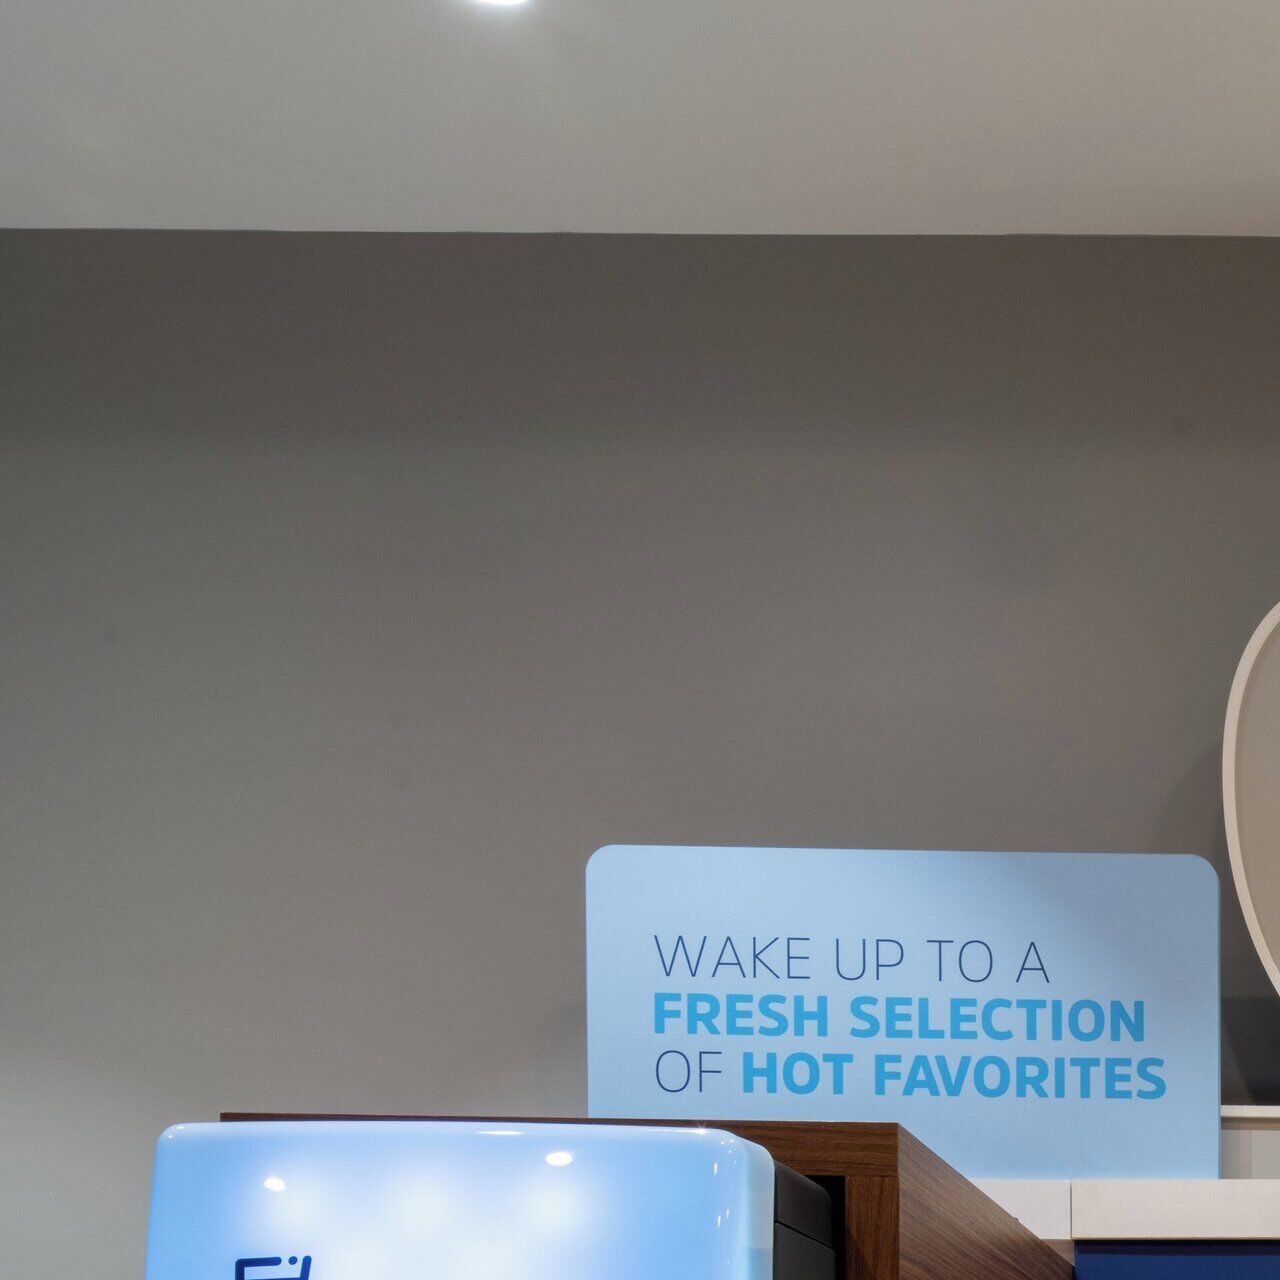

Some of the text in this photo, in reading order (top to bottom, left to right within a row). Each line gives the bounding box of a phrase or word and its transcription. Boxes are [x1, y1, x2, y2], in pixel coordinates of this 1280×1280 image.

[654, 935, 1051, 984] WAKE UP TO A
[653, 992, 1145, 1043] FRESH SELECTION
[654, 1050, 1167, 1102] OF HOT FAVORITES
